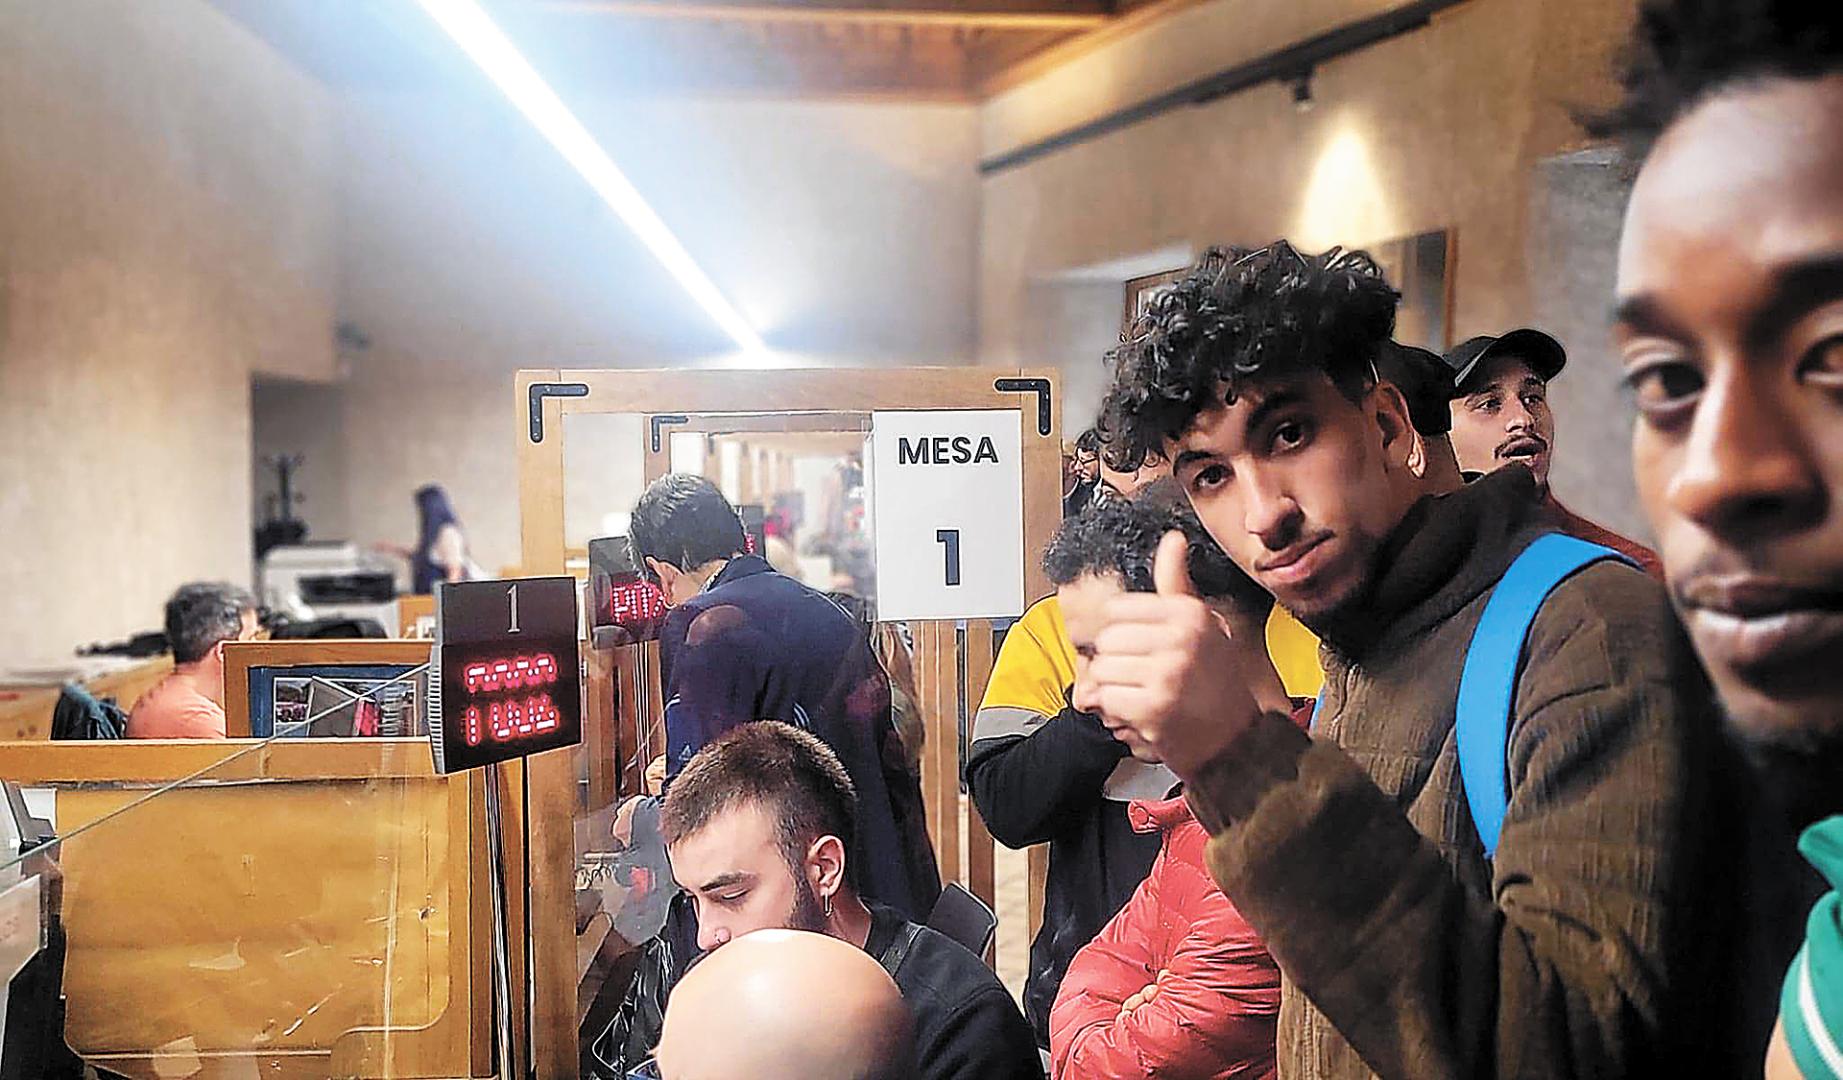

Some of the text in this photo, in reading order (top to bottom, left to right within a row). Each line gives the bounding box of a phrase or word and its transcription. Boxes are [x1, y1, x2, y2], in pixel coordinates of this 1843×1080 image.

[898, 436, 999, 465] MESA
[936, 529, 960, 585] 1
[506, 584, 521, 633] 1
